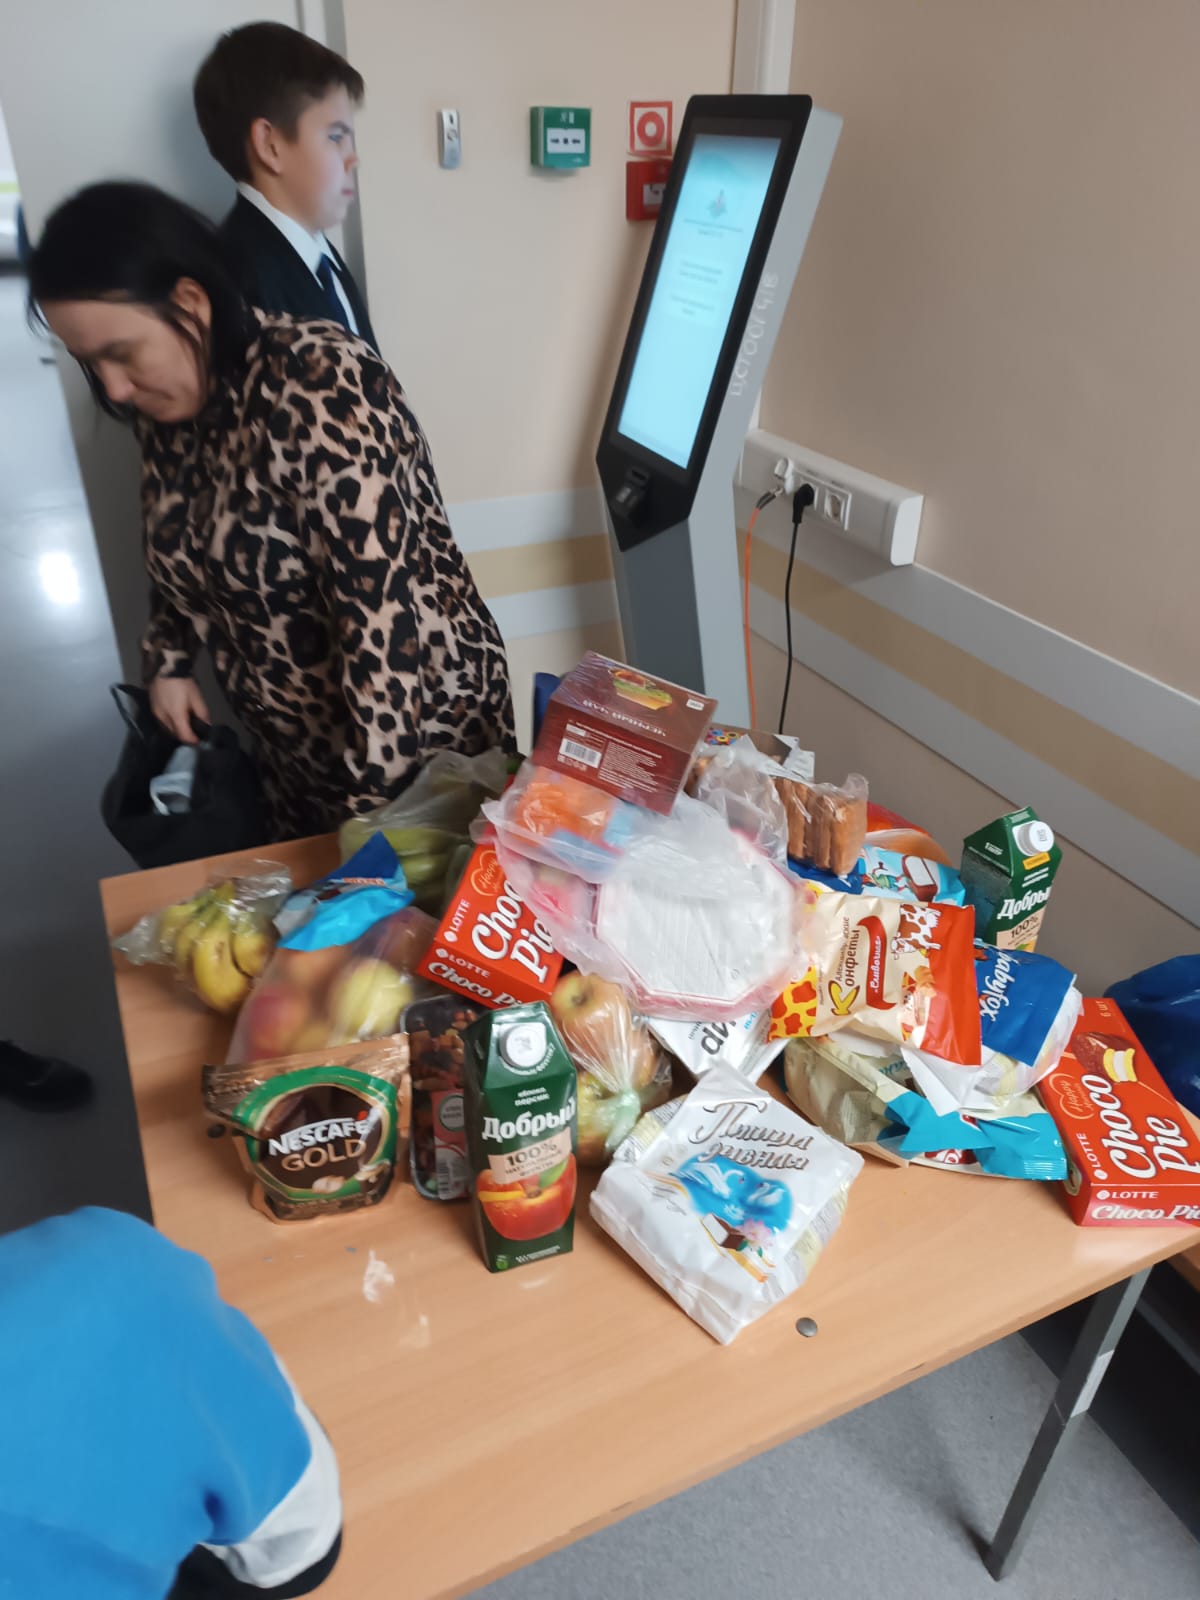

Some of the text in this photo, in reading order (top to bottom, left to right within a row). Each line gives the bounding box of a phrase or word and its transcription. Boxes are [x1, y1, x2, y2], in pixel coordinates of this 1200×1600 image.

[449, 899, 470, 933] LOTTE
[472, 880, 525, 959] Choc
[997, 886, 1052, 920] Добры
[447, 954, 490, 978] LOTTE
[428, 962, 523, 1008] Choco Pi
[482, 1097, 576, 1143] Добрый
[1081, 1074, 1157, 1178] Choco
[281, 1139, 368, 1172] GOLD
[506, 1140, 557, 1166] 100%
[1076, 1132, 1101, 1168] LOTTE
[1145, 1117, 1200, 1173] Pie
[1091, 1204, 1165, 1220] Choco
[1111, 1191, 1159, 1199] LOTTE
